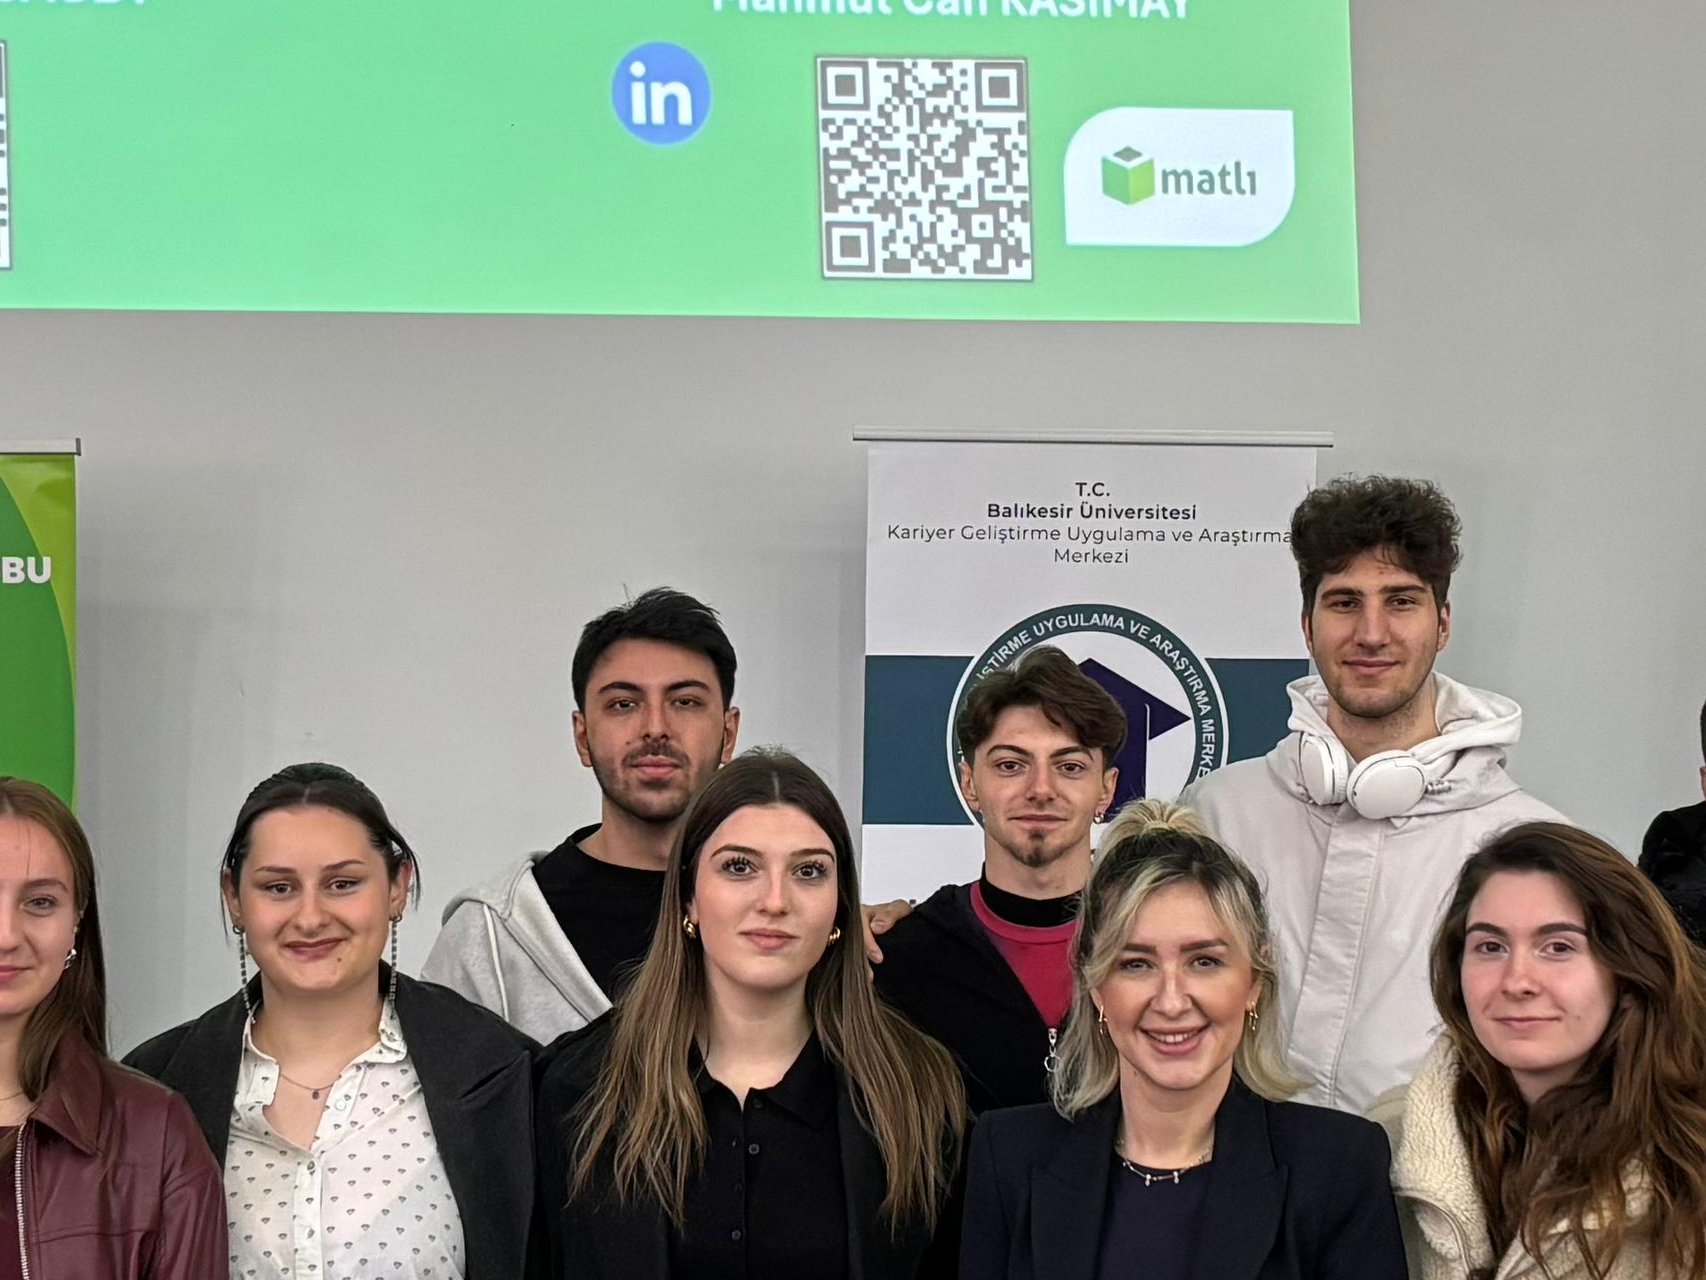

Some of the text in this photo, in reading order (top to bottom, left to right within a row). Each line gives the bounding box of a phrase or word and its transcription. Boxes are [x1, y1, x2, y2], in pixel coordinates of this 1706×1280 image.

[628, 60, 694, 126] in
[1075, 482, 1110, 498] T.C.
[987, 501, 1197, 521] Balıkesir Üniversitesi
[887, 524, 1292, 546] Kariyer Geliştirme Uygulama ve Araştırma
[1054, 547, 1129, 564] Merkezi
[1033, 613, 1125, 637] UYGULAMA
[1129, 620, 1152, 640] VE
[1149, 633, 1212, 717] ARAŞTIRMA
[1197, 718, 1215, 778] MERKE
